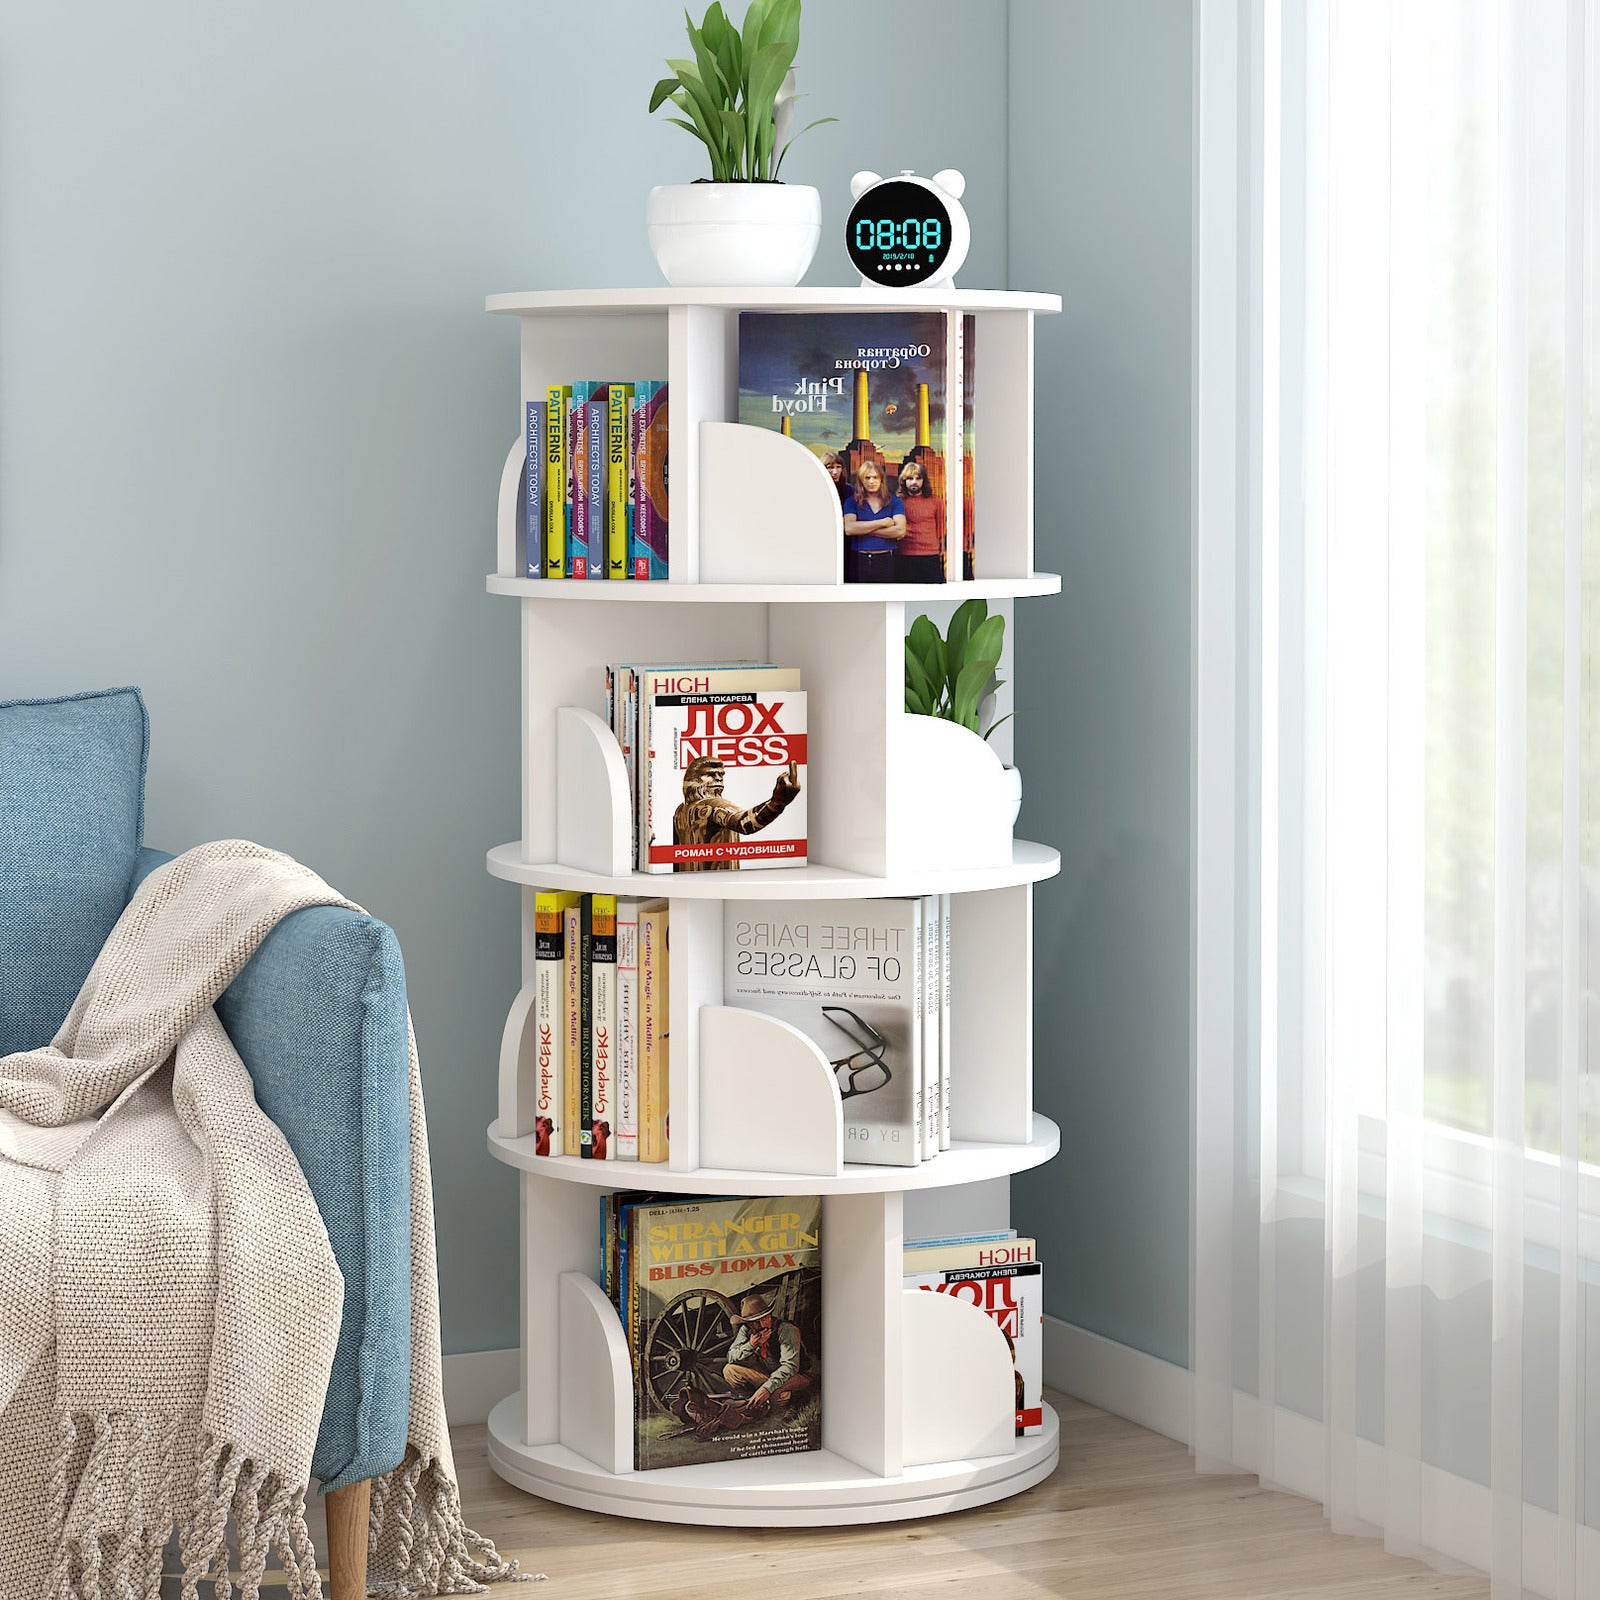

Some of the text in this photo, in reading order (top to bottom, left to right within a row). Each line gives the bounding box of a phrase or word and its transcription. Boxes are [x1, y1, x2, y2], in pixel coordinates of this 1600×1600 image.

[856, 218, 941, 250] 08:08
[529, 408, 538, 472] ARCHITECTS
[550, 390, 560, 464] PATTERNS
[592, 408, 600, 472] ARCHITECTS
[612, 390, 622, 464] PATTERNS
[529, 474, 538, 506] TODAY
[592, 474, 600, 506] TODAY
[654, 677, 709, 693] HIGH
[680, 695, 753, 704] ЕЛЕНА ТОКАРЕВА
[680, 702, 784, 737] ЛОХ
[681, 736, 788, 769] NESS
[674, 844, 795, 858] РОМАН С ЧУДОВИЩЕМ
[570, 998, 576, 1007] in
[645, 1004, 652, 1013] in
[538, 1023, 553, 1110] СуперСЕКС
[594, 1026, 609, 1114] СуперСЕКС
[650, 1213, 800, 1244] STRANGER
[650, 1228, 819, 1262] WITH A GUN
[649, 1253, 796, 1281] BLISS LOMAX
